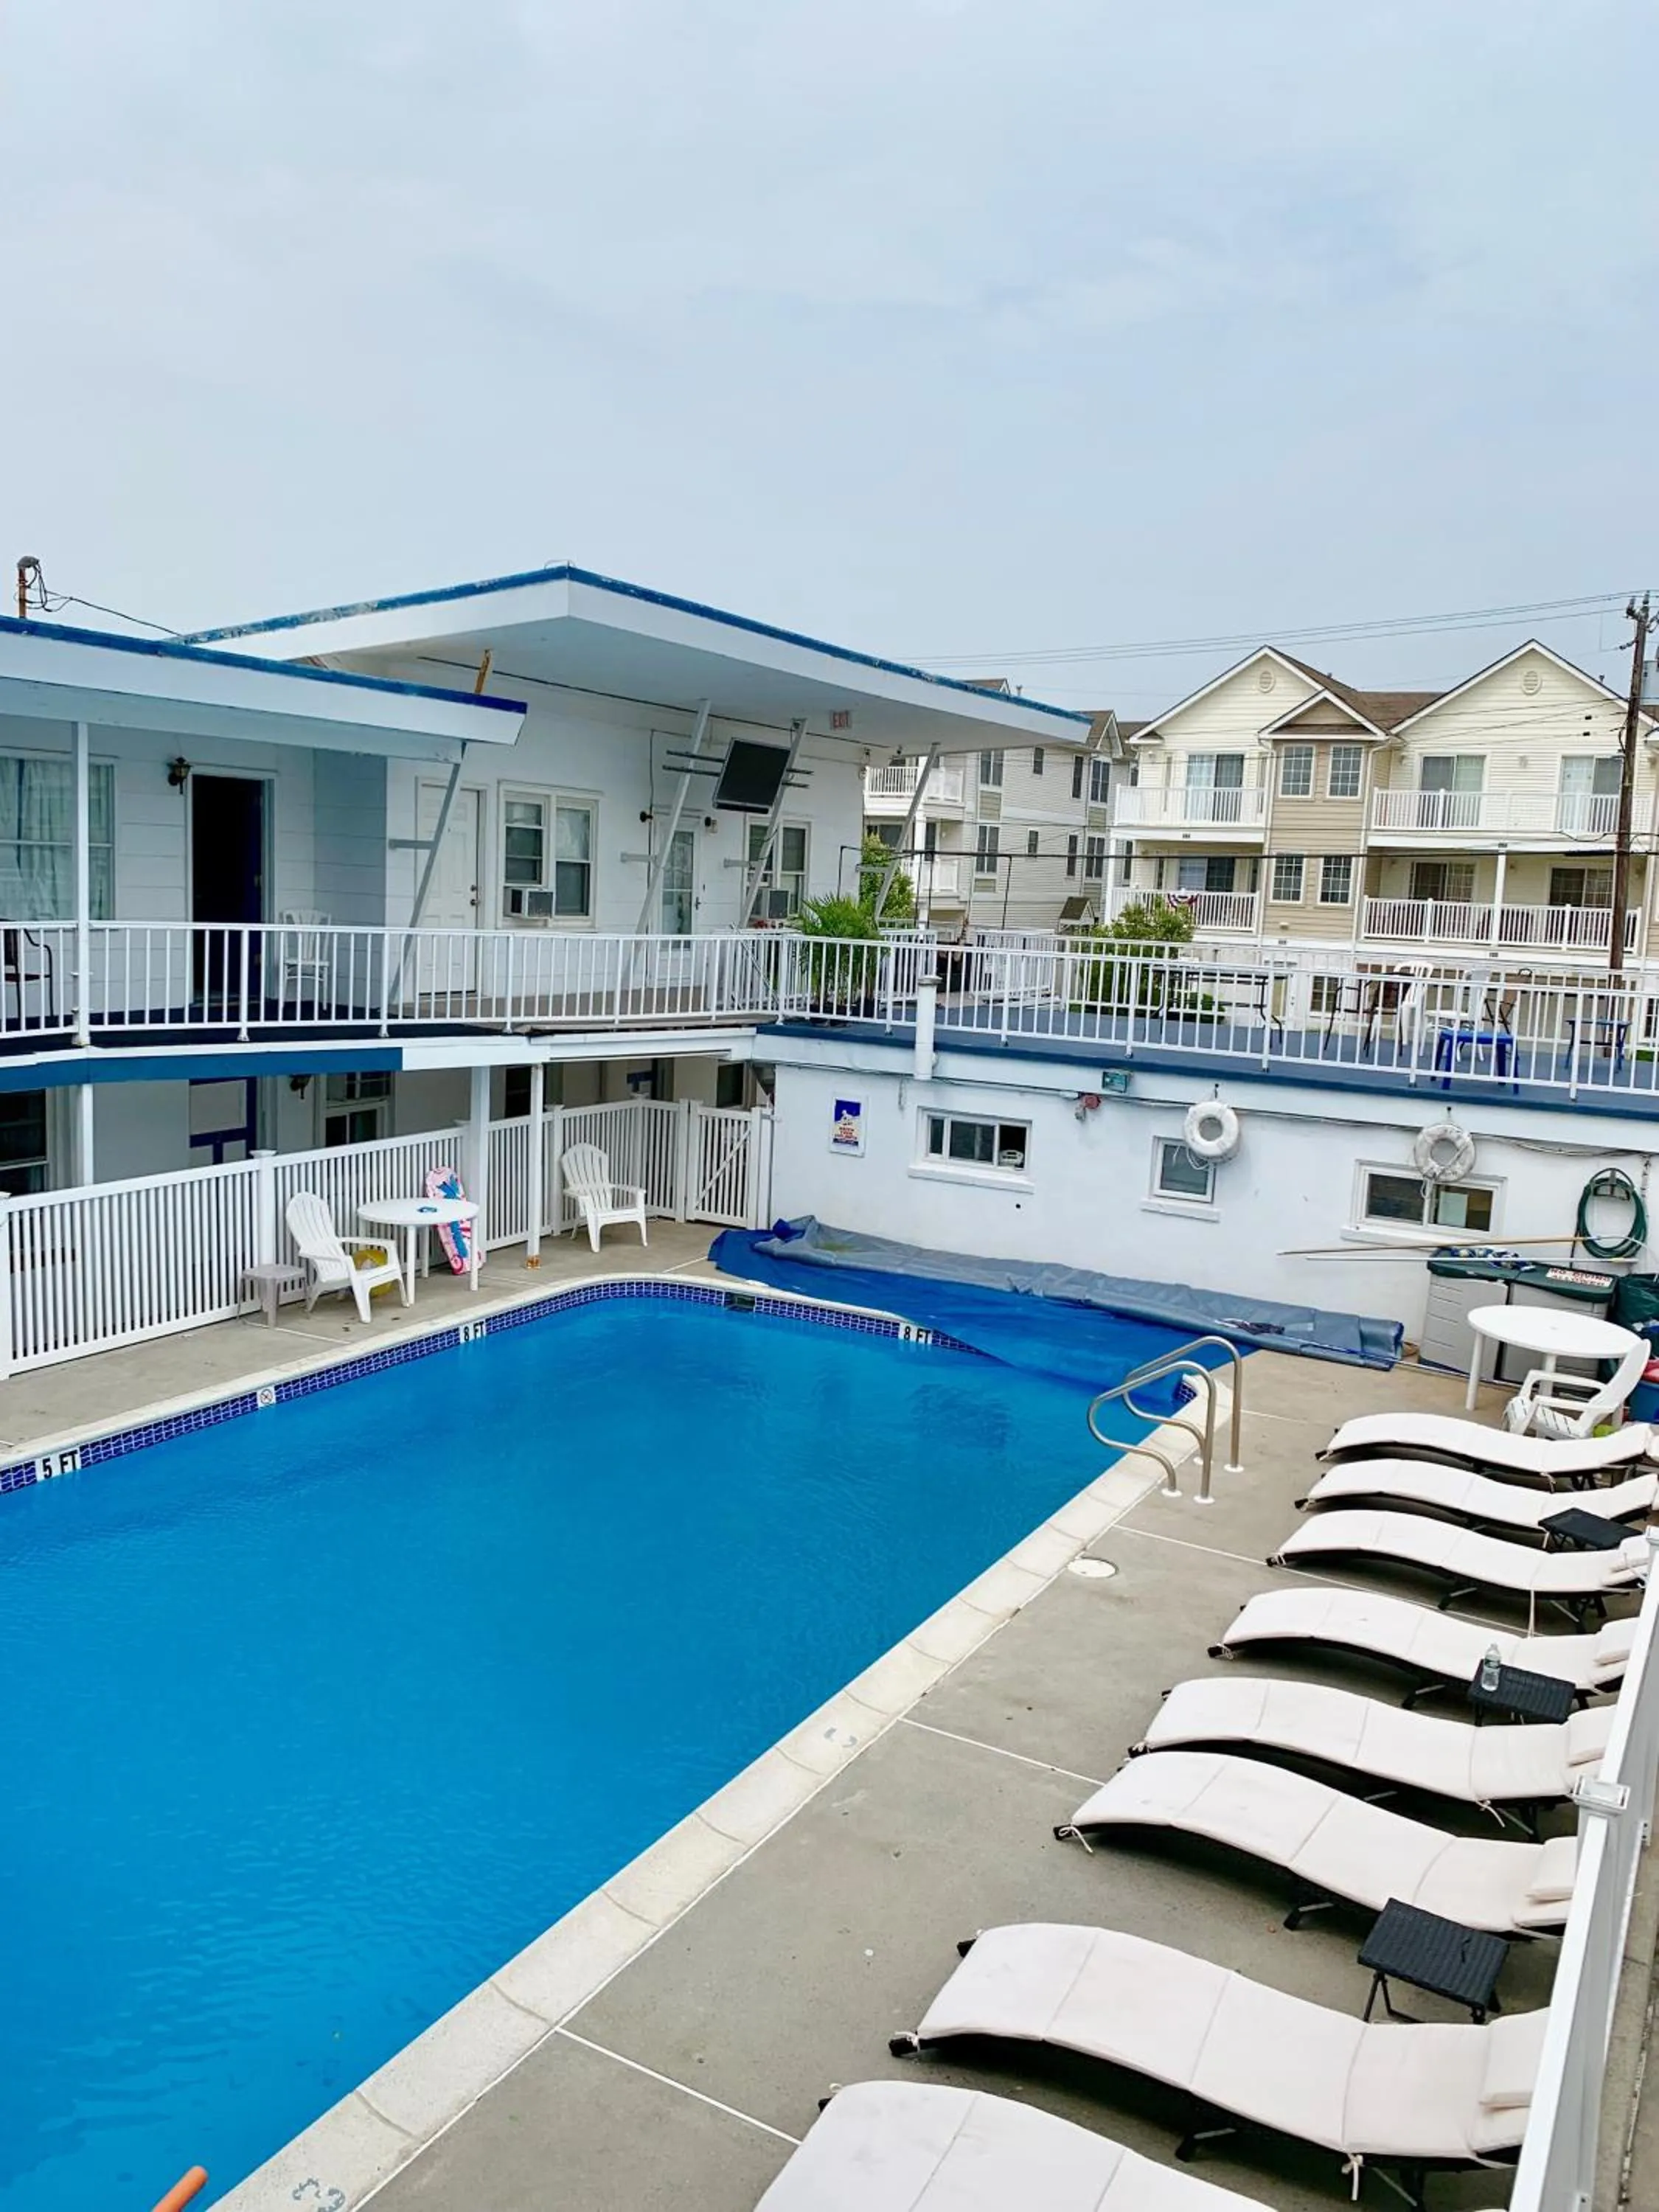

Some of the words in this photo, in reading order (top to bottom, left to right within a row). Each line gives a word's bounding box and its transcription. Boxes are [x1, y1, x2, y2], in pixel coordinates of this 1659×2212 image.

[463, 1326, 469, 1342] 8
[473, 1321, 484, 1340] FT
[904, 1326, 911, 1340] 8
[916, 1328, 931, 1344] FT
[42, 1457, 52, 1479] 5
[59, 1449, 78, 1474] FT
